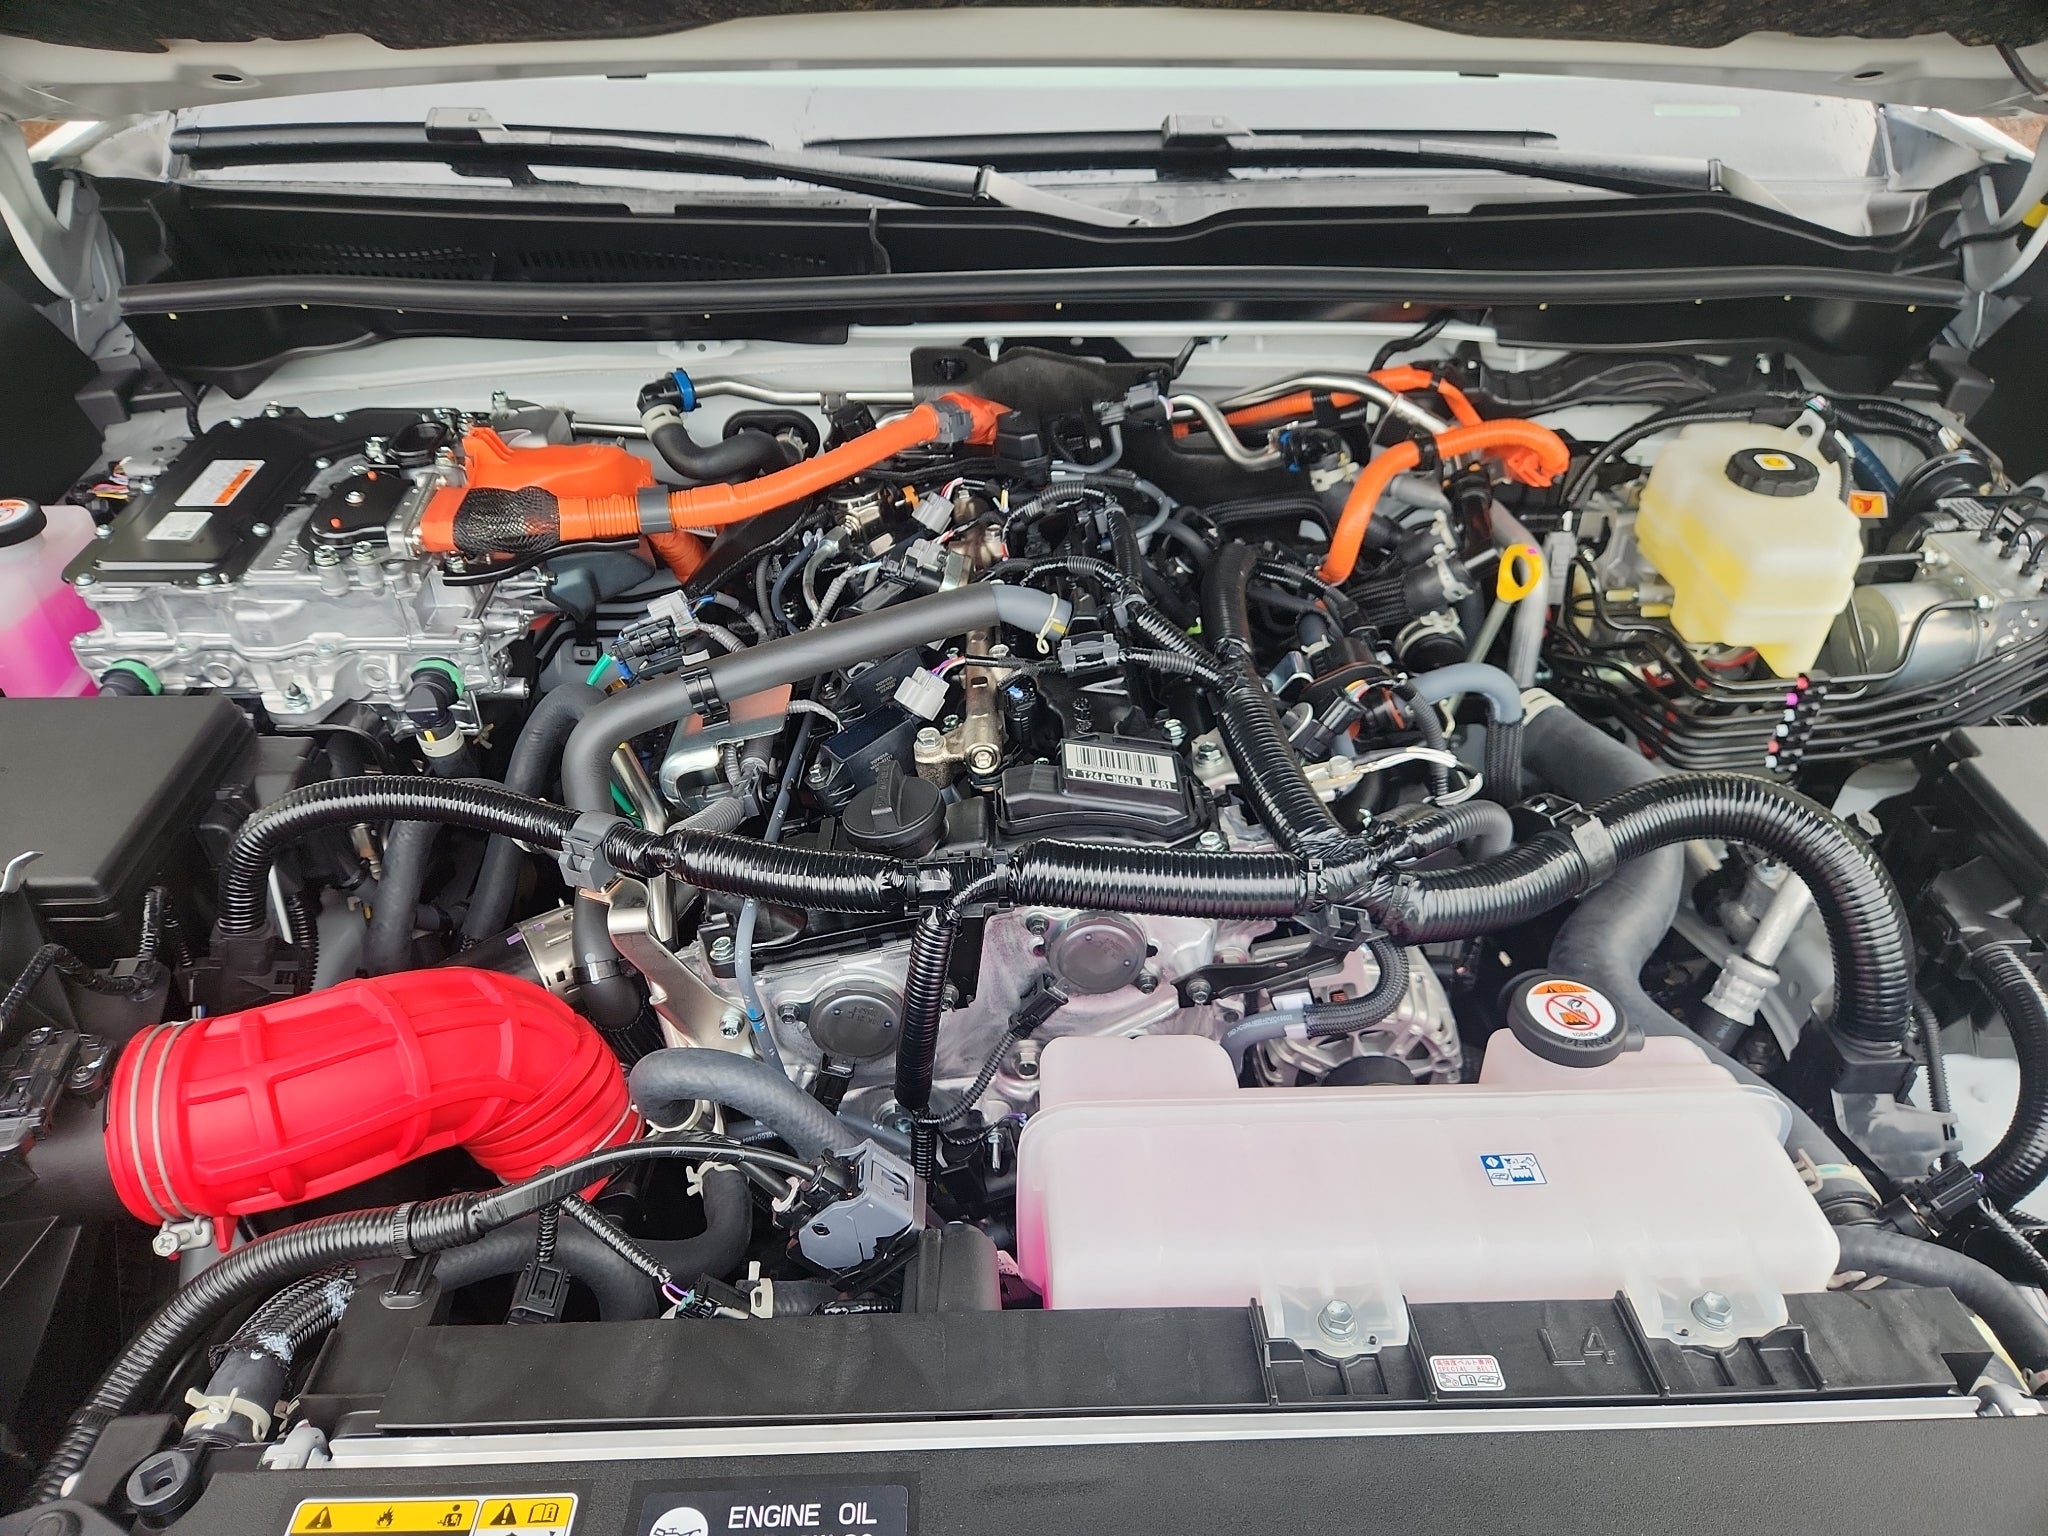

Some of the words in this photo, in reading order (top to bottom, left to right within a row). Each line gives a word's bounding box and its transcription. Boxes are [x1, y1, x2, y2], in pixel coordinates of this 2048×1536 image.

[870, 752, 889, 765] TOYOTA
[1070, 769, 1077, 777] T
[1082, 771, 1138, 785] T24A-N43A
[728, 1503, 821, 1529] ENGINE
[838, 1501, 878, 1525] OIL
